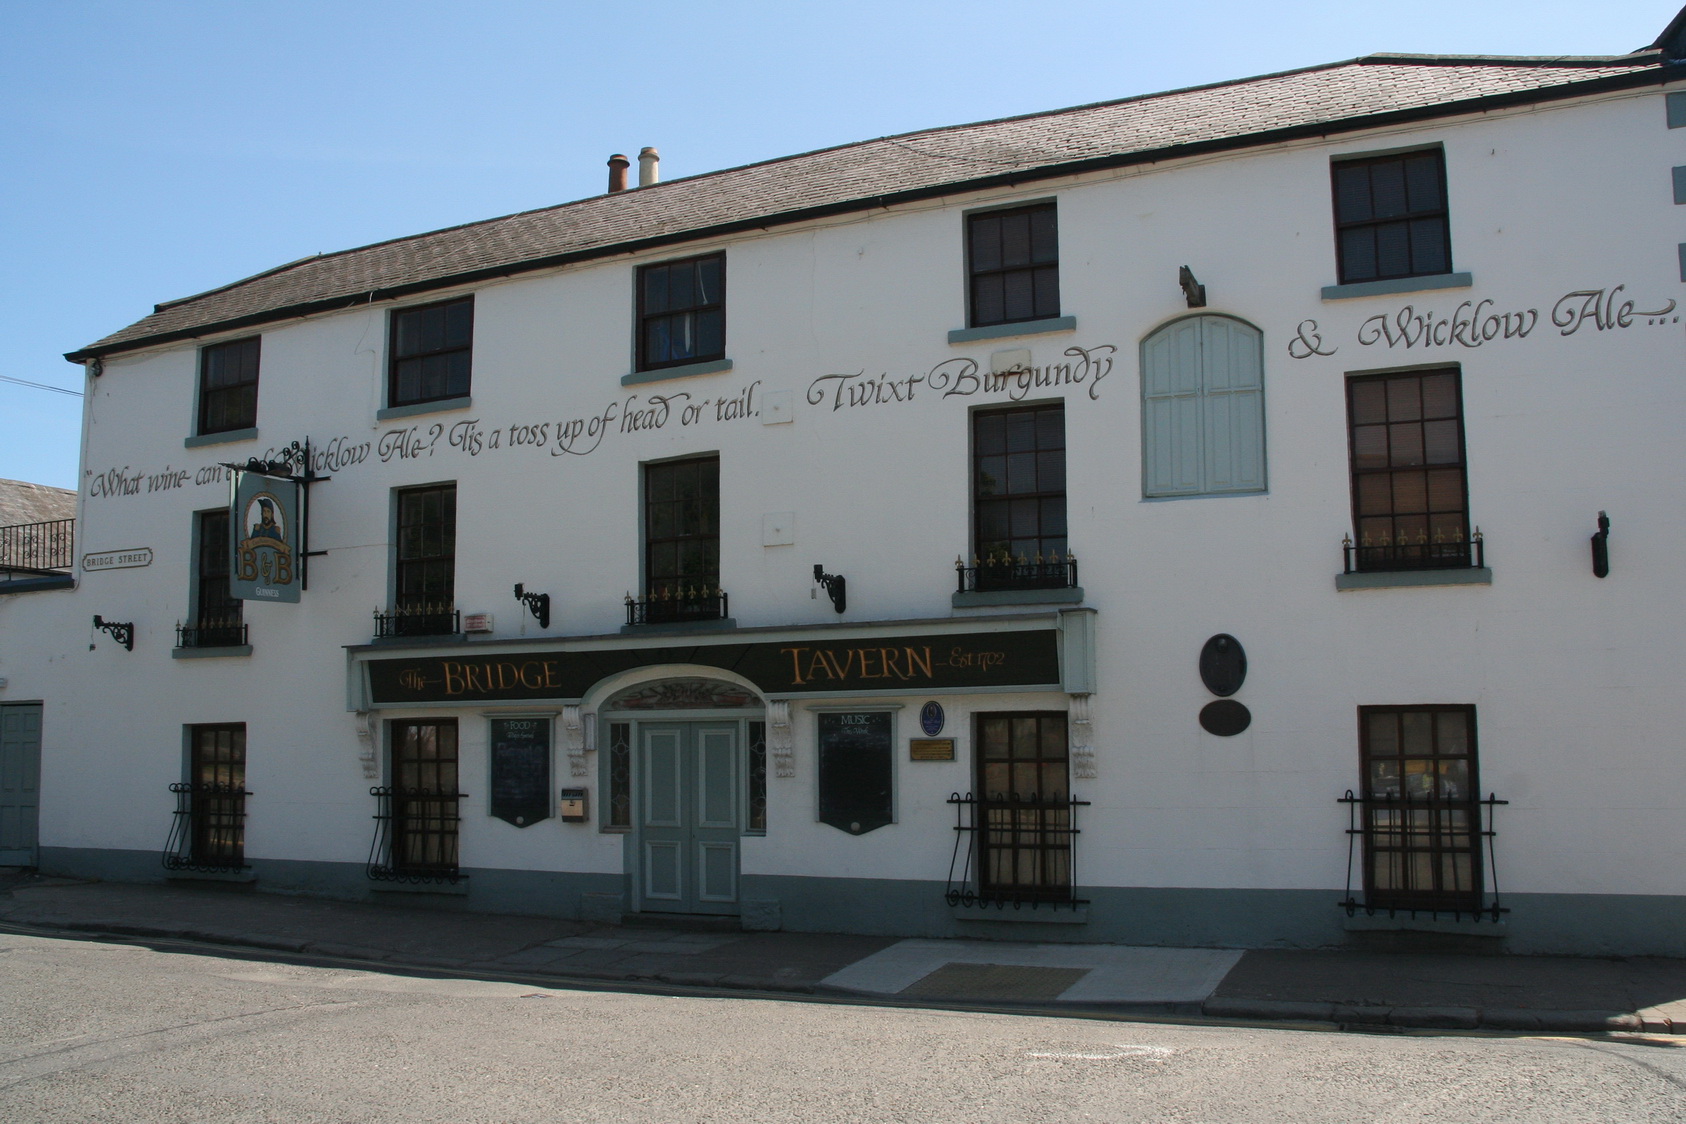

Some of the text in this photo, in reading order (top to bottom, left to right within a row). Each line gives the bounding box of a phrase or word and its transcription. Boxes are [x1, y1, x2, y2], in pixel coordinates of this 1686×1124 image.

[147, 465, 191, 494] wine
[195, 465, 222, 486] can
[378, 423, 444, 462] Ale?
[488, 427, 501, 449] a
[508, 420, 550, 448] toss
[551, 419, 589, 457] up
[587, 401, 616, 456] of
[621, 392, 692, 433] head
[681, 399, 708, 426] or
[716, 379, 762, 422] tail.
[806, 368, 926, 412] Twixt
[928, 344, 1117, 401] Burgundy
[1287, 319, 1339, 359] &
[1357, 299, 1539, 349] Wicklow
[86, 553, 148, 567] BRIDGE STREET
[399, 646, 1005, 695] The BRIDGE TAVERN Est 1702
[510, 721, 531, 730] FOOD
[841, 714, 870, 725] MUSIC
